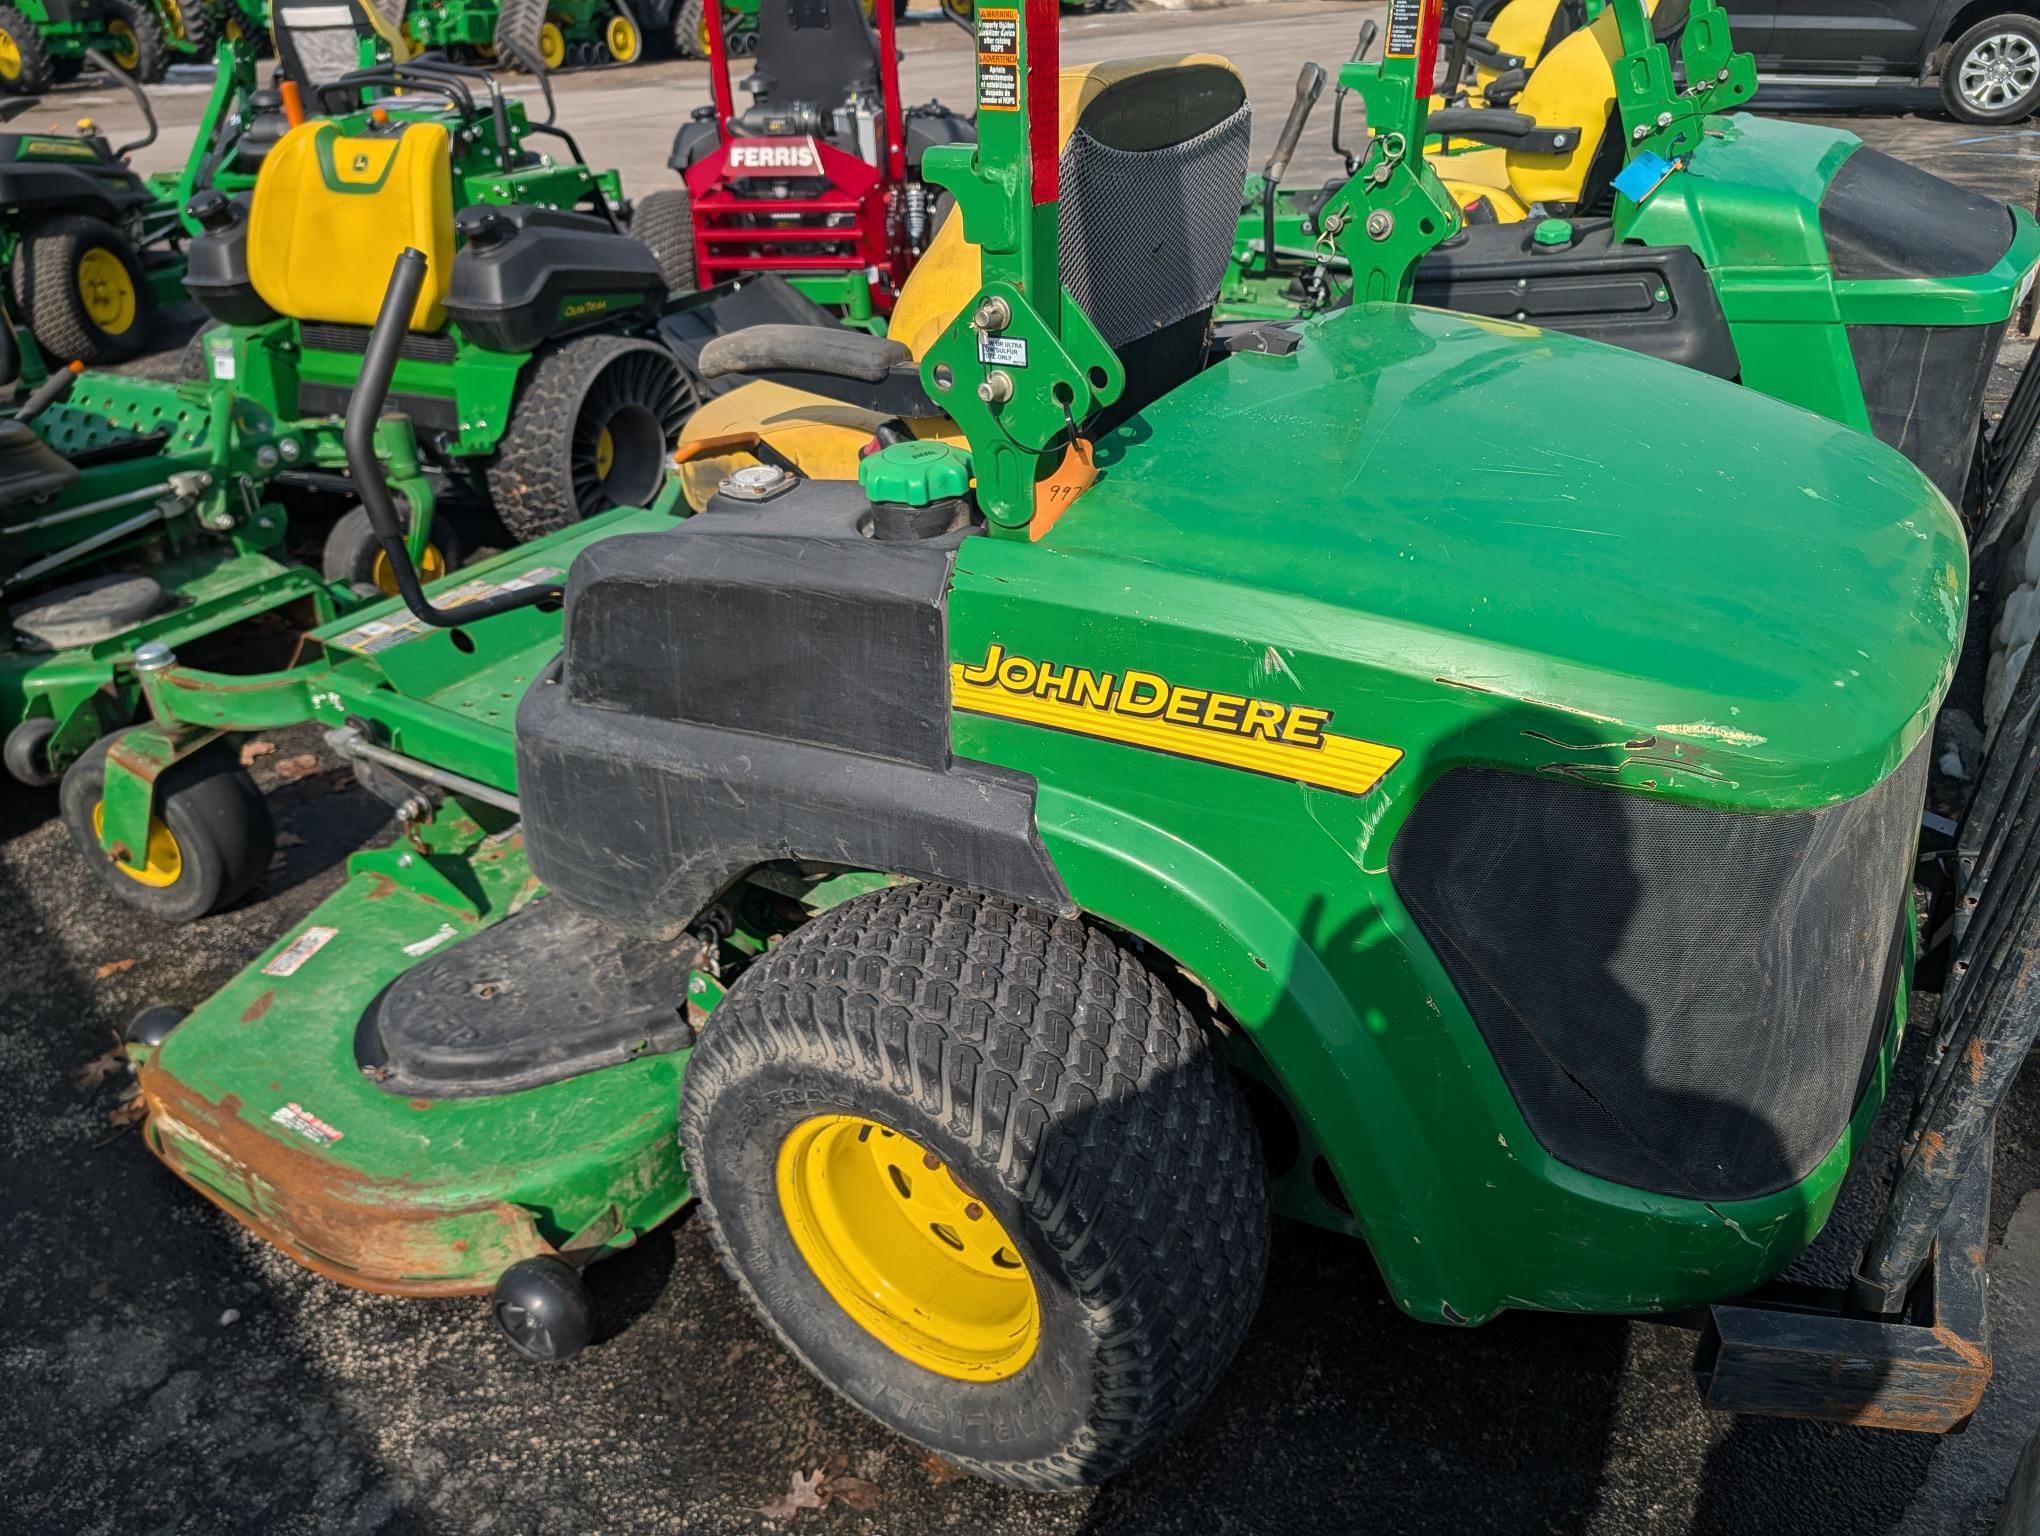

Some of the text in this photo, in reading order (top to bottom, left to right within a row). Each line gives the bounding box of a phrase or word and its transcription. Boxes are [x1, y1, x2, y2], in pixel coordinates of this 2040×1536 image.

[986, 10, 1014, 18] WARNING
[979, 20, 998, 30] roperly
[995, 37, 1011, 46] raising
[991, 44, 1004, 52] ROPS
[986, 81, 1015, 89] estabilizador
[1003, 97, 1015, 105] ROPS
[730, 146, 813, 167] FERRIS
[996, 347, 1018, 355] SULFUR
[912, 450, 937, 460] DIESEL
[1050, 485, 1082, 502] 997
[963, 644, 1334, 750] JOHN DEERE
